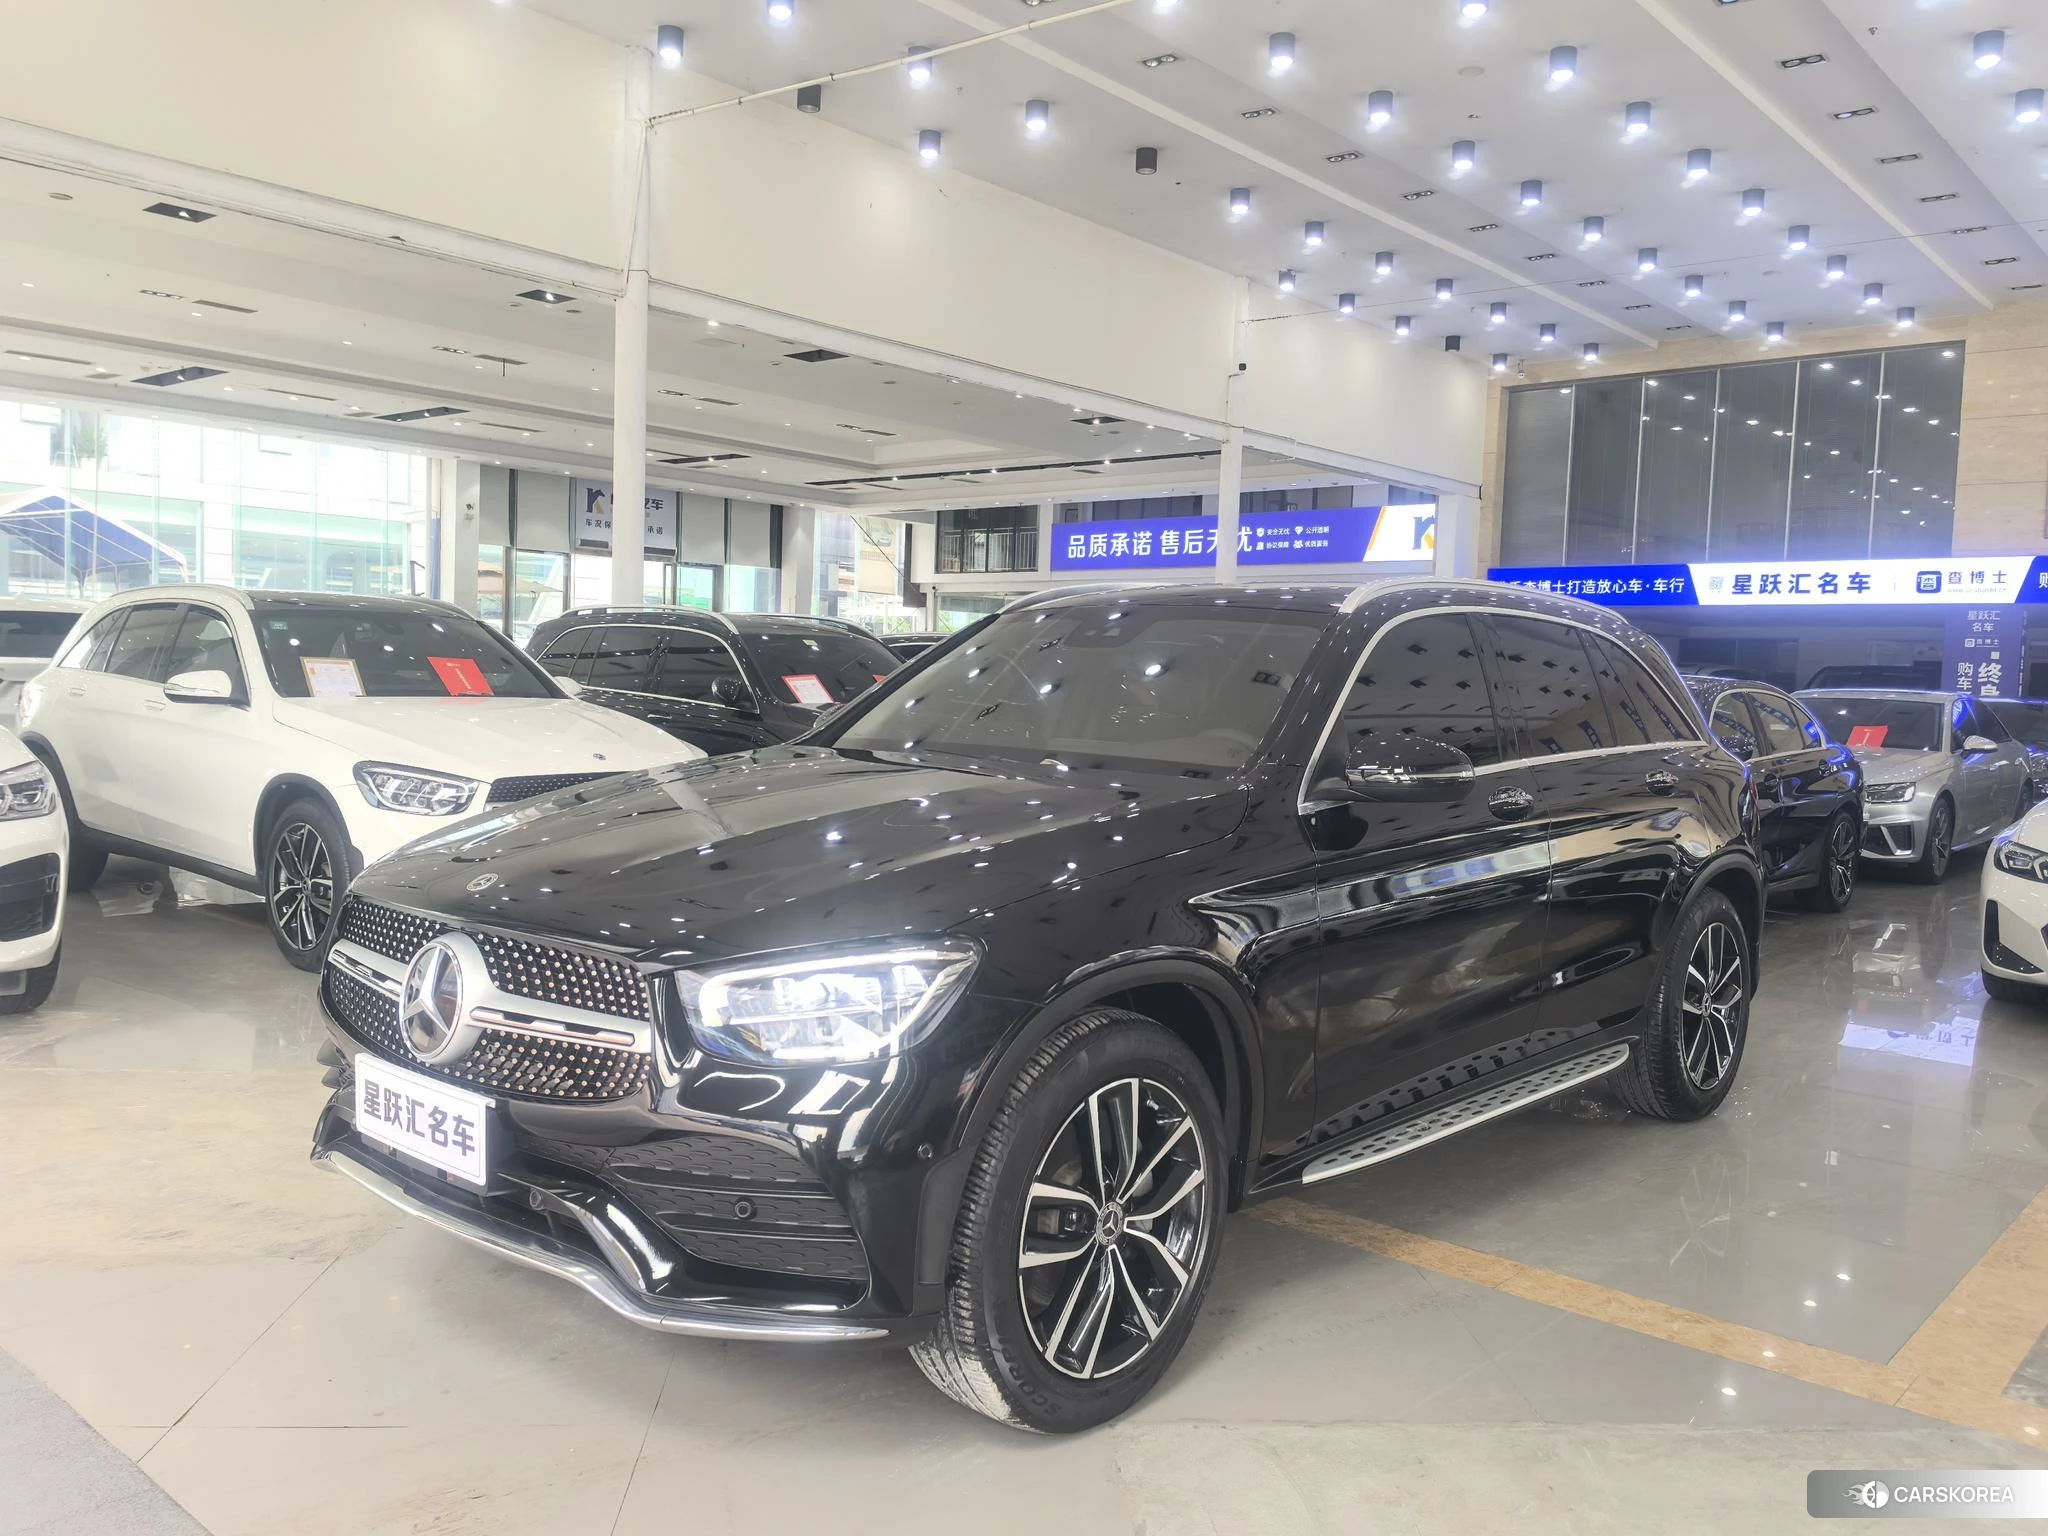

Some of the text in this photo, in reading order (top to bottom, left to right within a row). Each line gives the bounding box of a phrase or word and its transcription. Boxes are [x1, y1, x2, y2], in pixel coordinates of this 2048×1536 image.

[1068, 531, 1152, 559] 品质承诺
[1731, 571, 1872, 595] 星跃汇名车
[1947, 570, 2008, 585] 查博士
[1967, 610, 2001, 620] 星跃汇
[1972, 622, 1995, 632] 名车
[363, 1078, 476, 1157] 星跃汇名车
